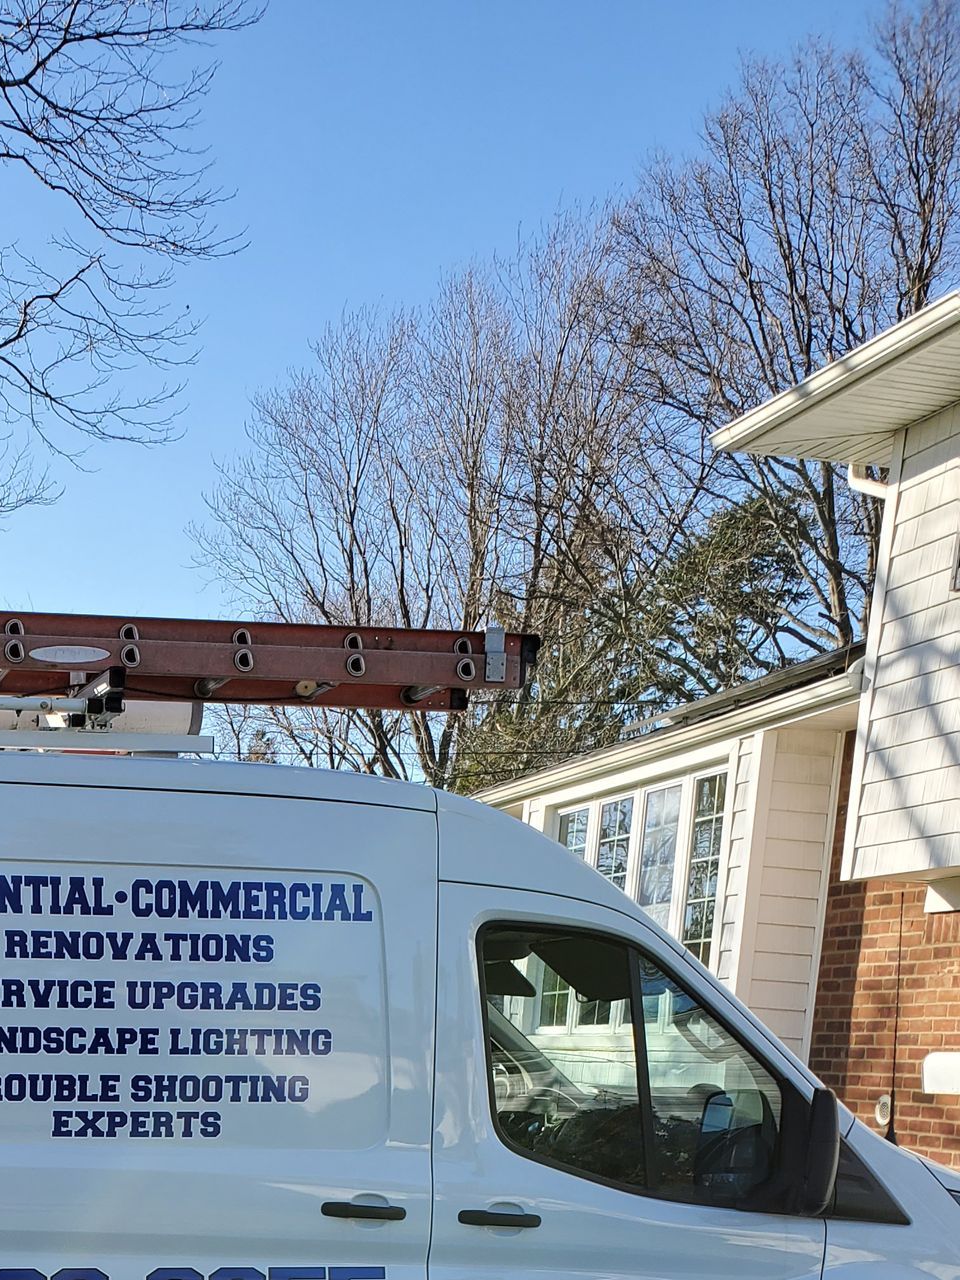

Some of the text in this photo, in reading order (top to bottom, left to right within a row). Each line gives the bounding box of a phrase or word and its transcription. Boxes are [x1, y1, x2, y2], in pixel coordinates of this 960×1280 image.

[3, 930, 275, 963] RENOVATIONS
[125, 981, 322, 1011] UPGRADES
[168, 1028, 333, 1056] LIGHTING
[130, 1074, 310, 1103] SHOOTING
[51, 1111, 222, 1138] EXPERTS
